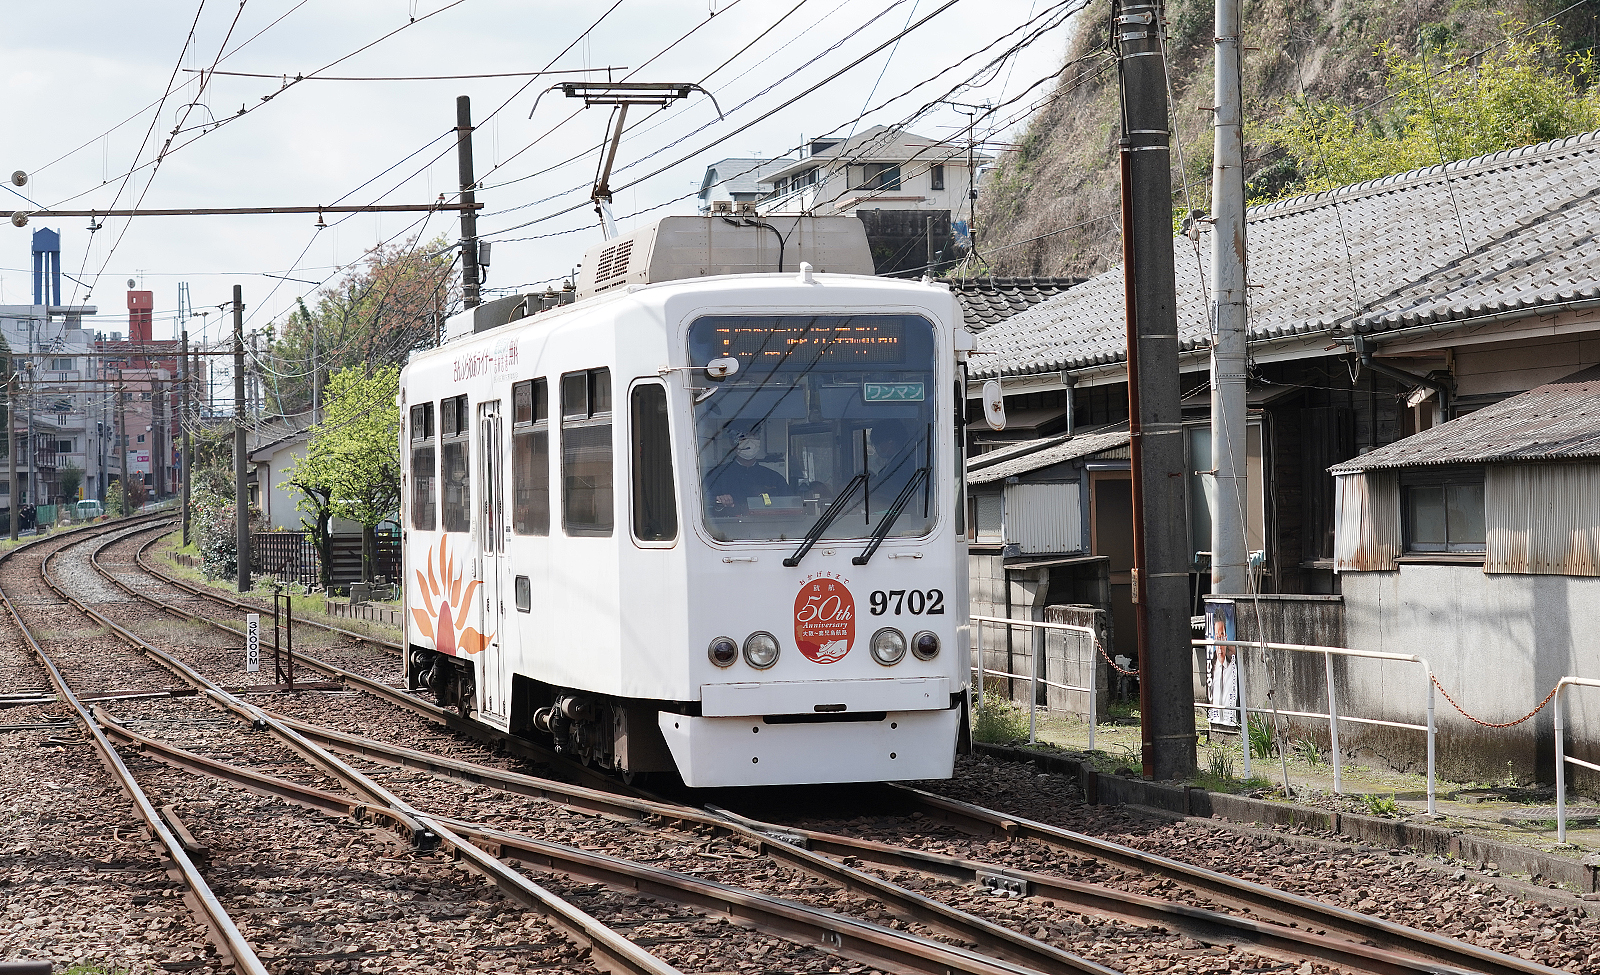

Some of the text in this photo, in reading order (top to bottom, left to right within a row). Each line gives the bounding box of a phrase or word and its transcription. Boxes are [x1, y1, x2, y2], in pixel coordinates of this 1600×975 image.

[867, 385, 922, 399] ワンマン
[799, 570, 850, 586] おかげさまで
[796, 594, 853, 622] 50th
[869, 588, 945, 616] 9702
[802, 621, 848, 630] Anniversary
